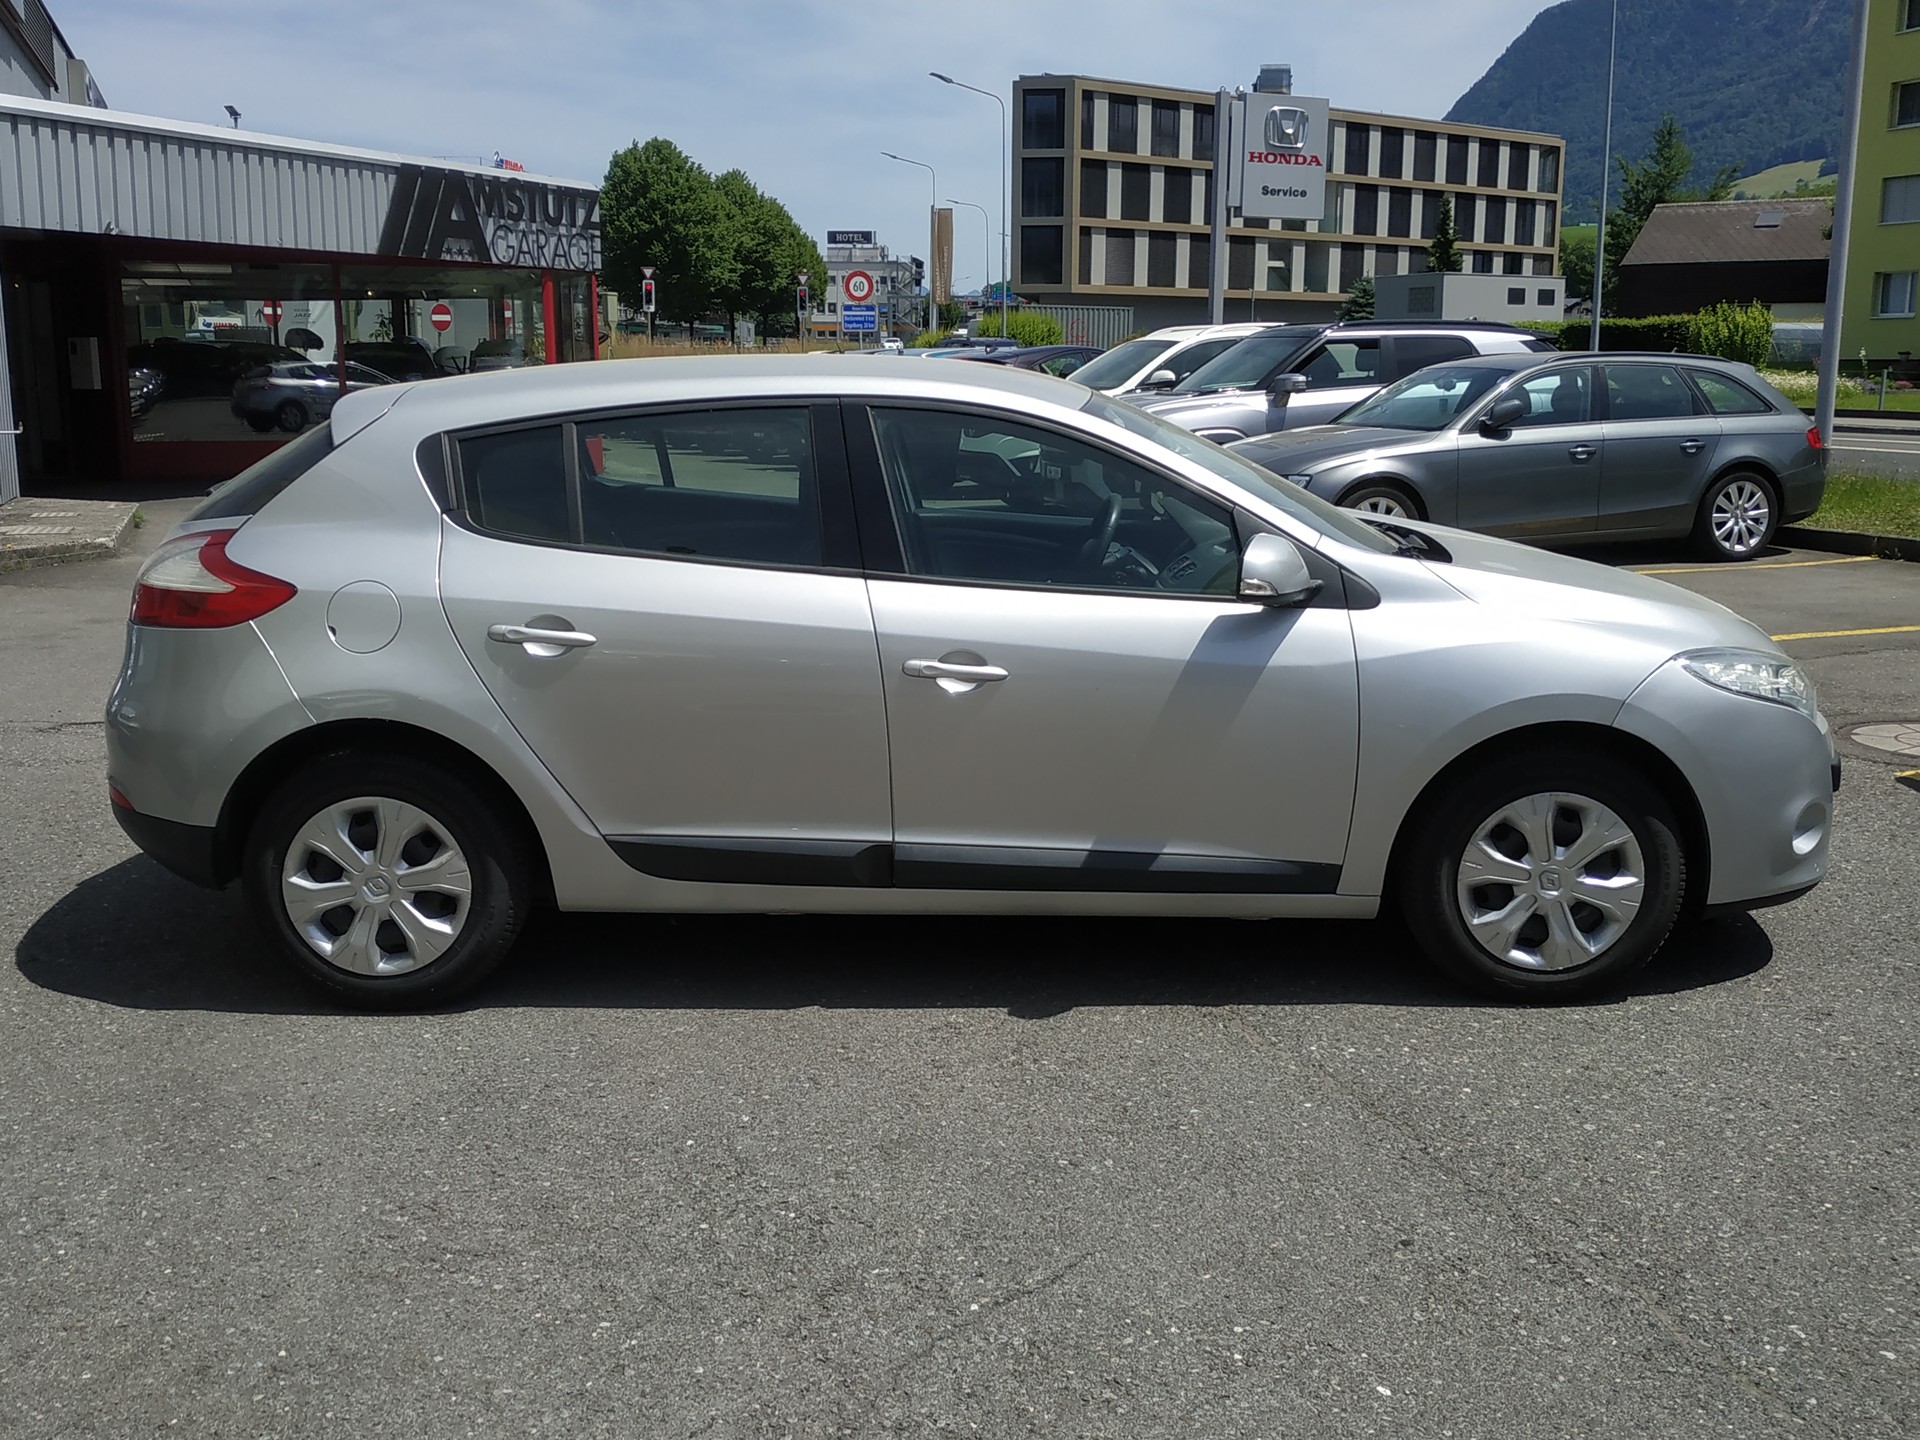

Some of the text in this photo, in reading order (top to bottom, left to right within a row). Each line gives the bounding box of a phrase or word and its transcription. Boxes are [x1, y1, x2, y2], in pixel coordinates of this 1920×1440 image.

[1248, 151, 1323, 167] HONDA
[1261, 185, 1308, 198] Service
[427, 170, 601, 262] AMSTUTZ
[835, 233, 864, 242] HOTEL
[491, 224, 602, 272] GARAGE
[852, 281, 865, 292] 60
